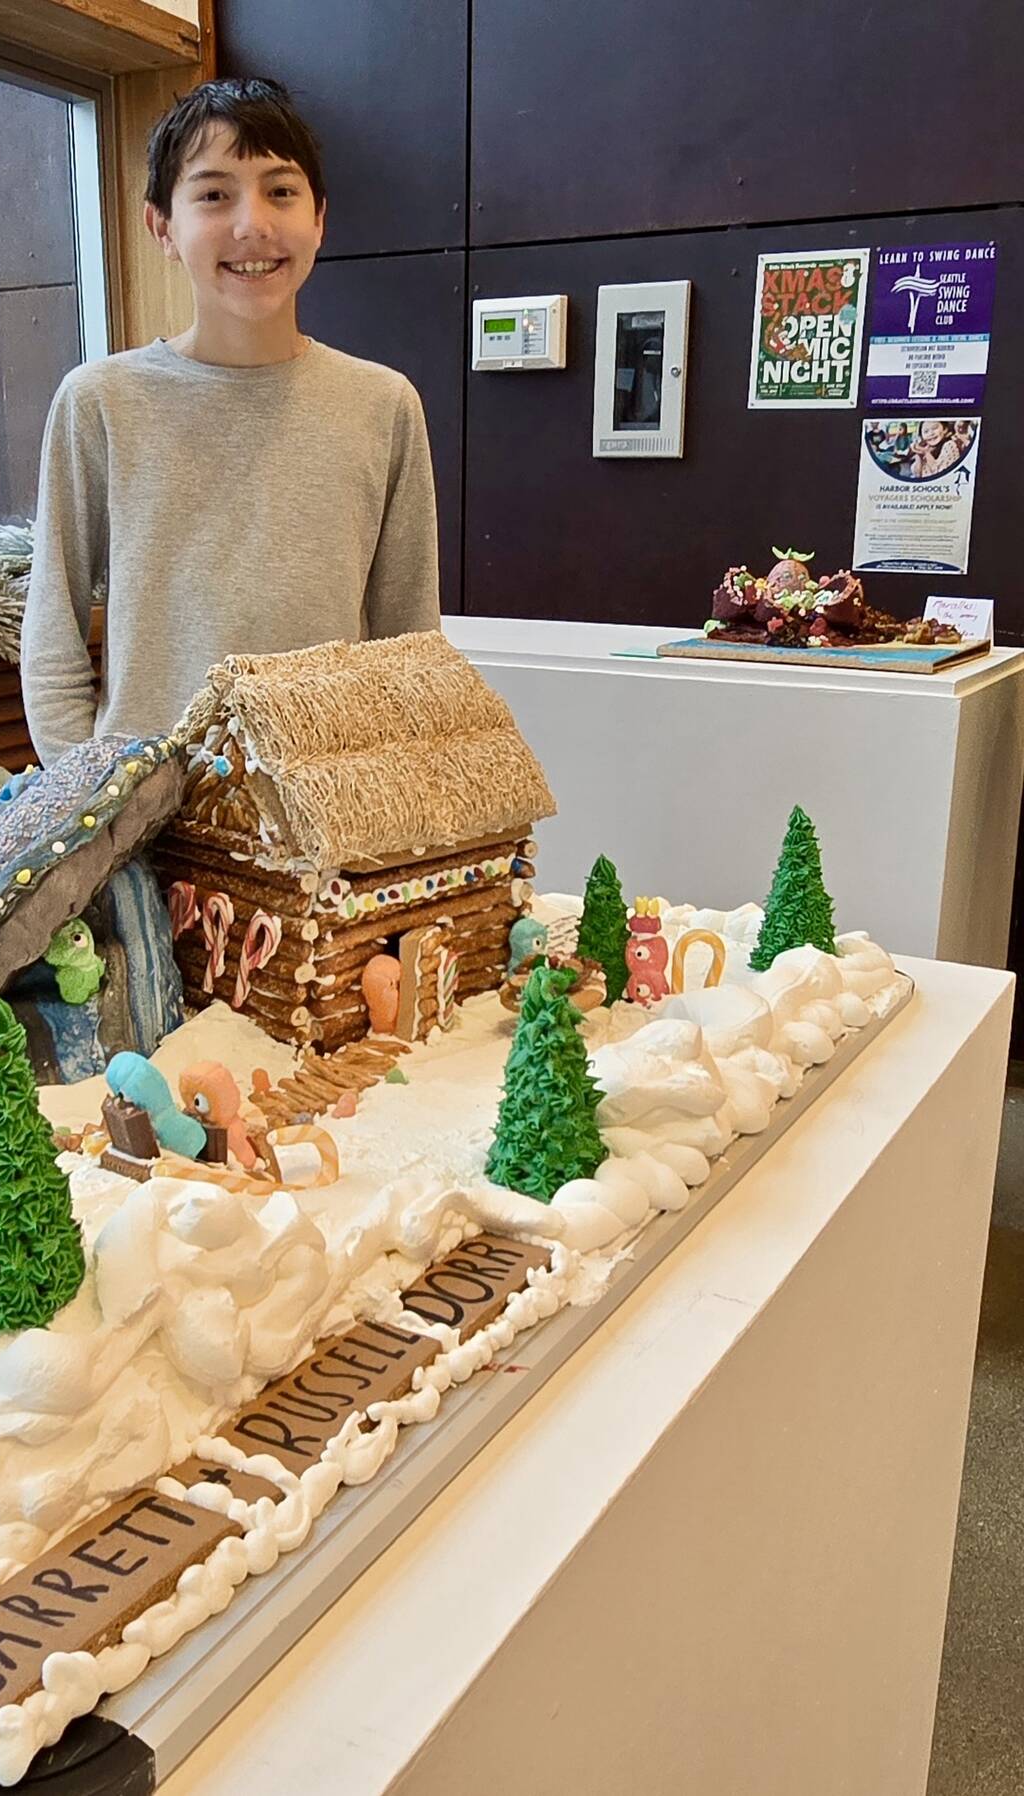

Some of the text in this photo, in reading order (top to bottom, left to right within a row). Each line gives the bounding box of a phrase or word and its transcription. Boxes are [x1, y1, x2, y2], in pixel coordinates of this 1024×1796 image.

[879, 247, 995, 264] LEARN TO SWING DANCE
[763, 266, 843, 292] XMAS
[940, 273, 966, 284] SEATTLE
[761, 290, 853, 317] STACK
[938, 285, 970, 300] SWING
[936, 299, 967, 314] DANCE
[782, 314, 852, 338] OPEN
[935, 315, 954, 325] CLUB
[798, 336, 850, 360] MIC
[762, 360, 850, 384] NIGHT
[234, 1319, 421, 1458] RUSSELL
[399, 1240, 525, 1328] DORR
